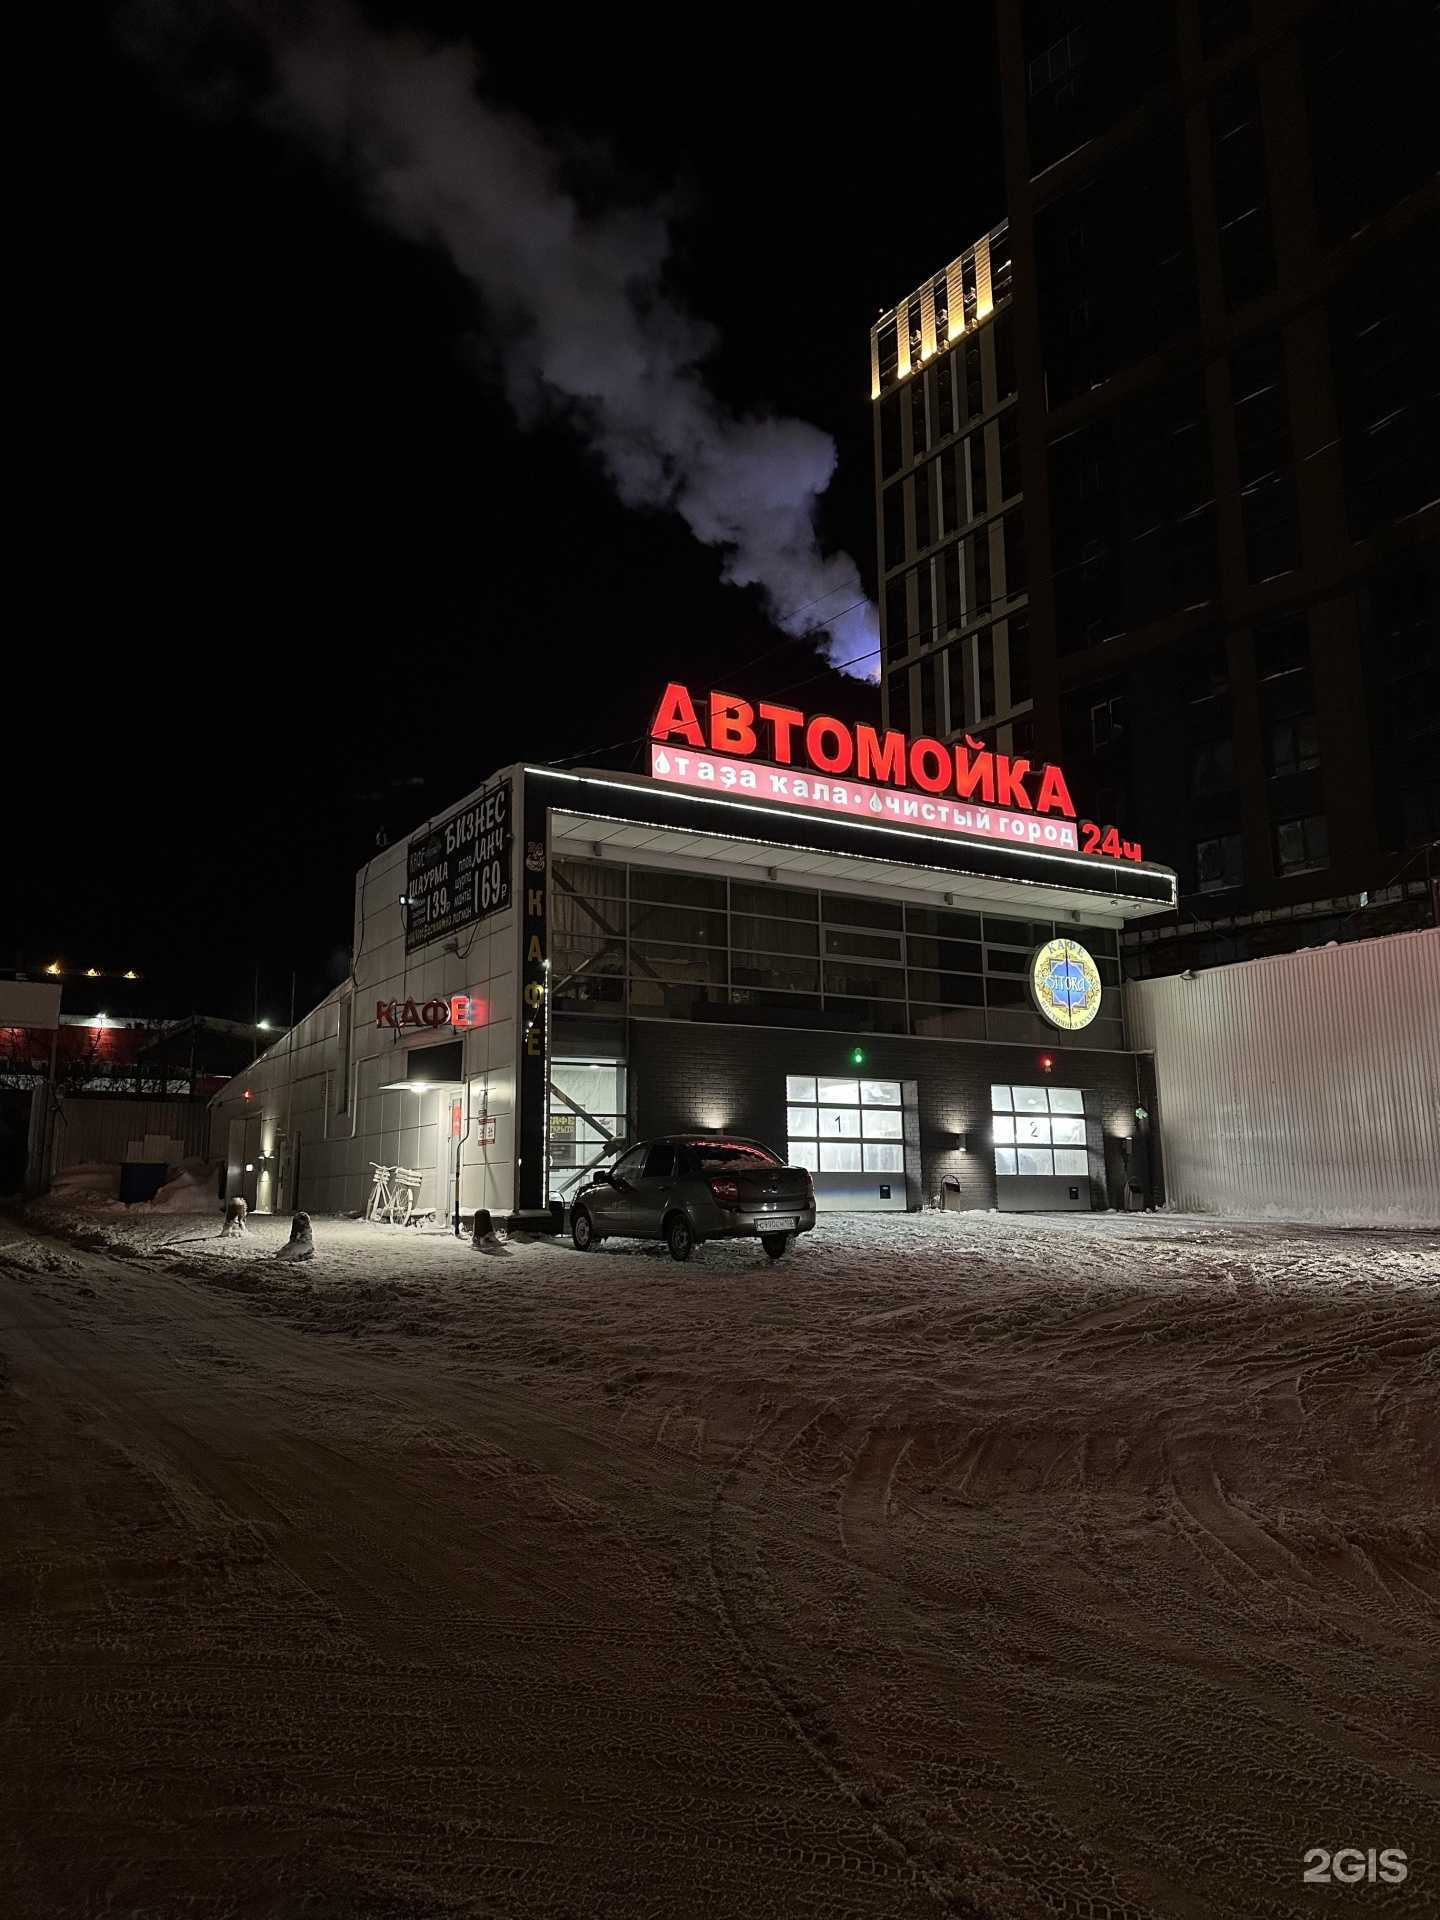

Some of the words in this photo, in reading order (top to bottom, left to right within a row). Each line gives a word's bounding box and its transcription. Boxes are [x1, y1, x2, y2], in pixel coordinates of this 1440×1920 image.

[651, 682, 1077, 817] АВТОМОЙКА
[444, 791, 506, 855] БИЗНЕС
[886, 799, 991, 830] чистый
[998, 816, 1074, 848] город
[471, 827, 503, 866] ЛАНЧ
[1081, 823, 1142, 863] 24ч
[409, 861, 449, 898] ШАУРМА
[524, 889, 545, 1056] КАФЕ
[376, 995, 470, 1029] КАФЕ
[834, 1114, 842, 1133] 1
[1029, 1121, 1040, 1138] 2
